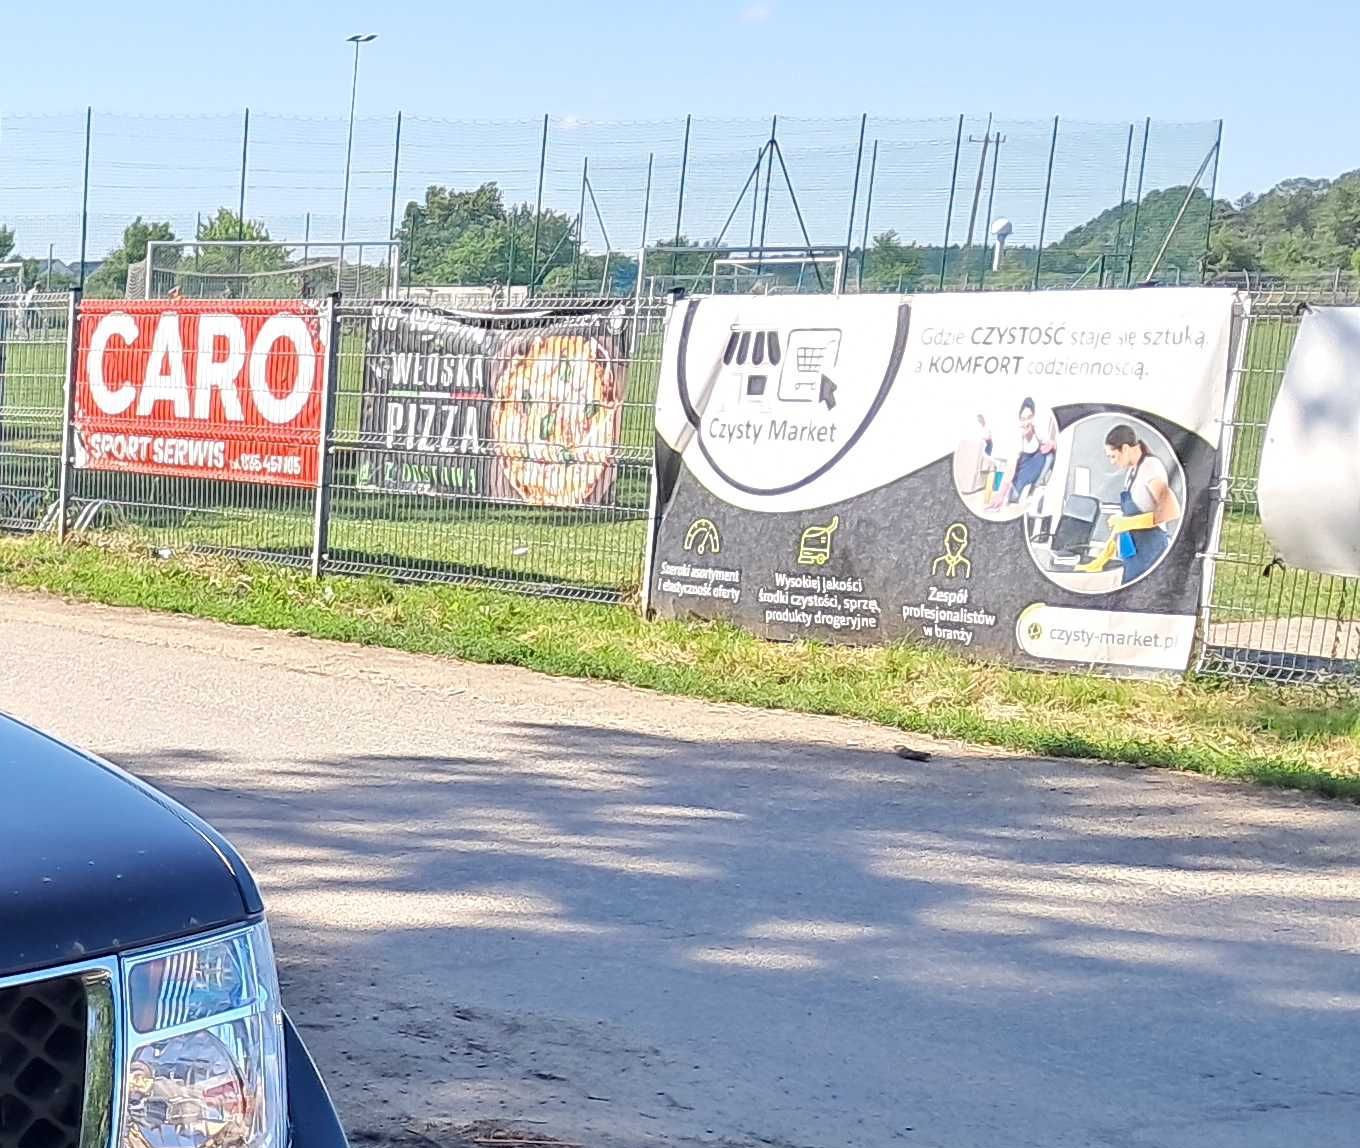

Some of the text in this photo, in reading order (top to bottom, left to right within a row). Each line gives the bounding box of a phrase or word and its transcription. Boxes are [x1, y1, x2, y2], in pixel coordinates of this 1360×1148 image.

[921, 327, 965, 345] Gdzie
[970, 321, 1066, 345] CZYSTOŚĆ
[1070, 328, 1111, 349] staje
[86, 311, 316, 424] CARO
[392, 351, 484, 388] WŁOSKA
[929, 355, 1024, 376] KOMFORT
[386, 402, 479, 454] PIZZA
[709, 418, 837, 445] Czysty Market
[91, 432, 225, 469] SPORT SERWIS
[691, 567, 740, 584] asortyment
[775, 572, 820, 593] Wysokiej
[713, 584, 740, 604] oferty
[758, 587, 789, 605] środki
[791, 593, 841, 611] czystości,
[927, 586, 968, 607] Zespół
[765, 608, 877, 631] produkty drogeryjne
[902, 603, 996, 626] profesjonalistów
[923, 623, 973, 646] w branży
[1049, 628, 1178, 651] czysty-market.pl
